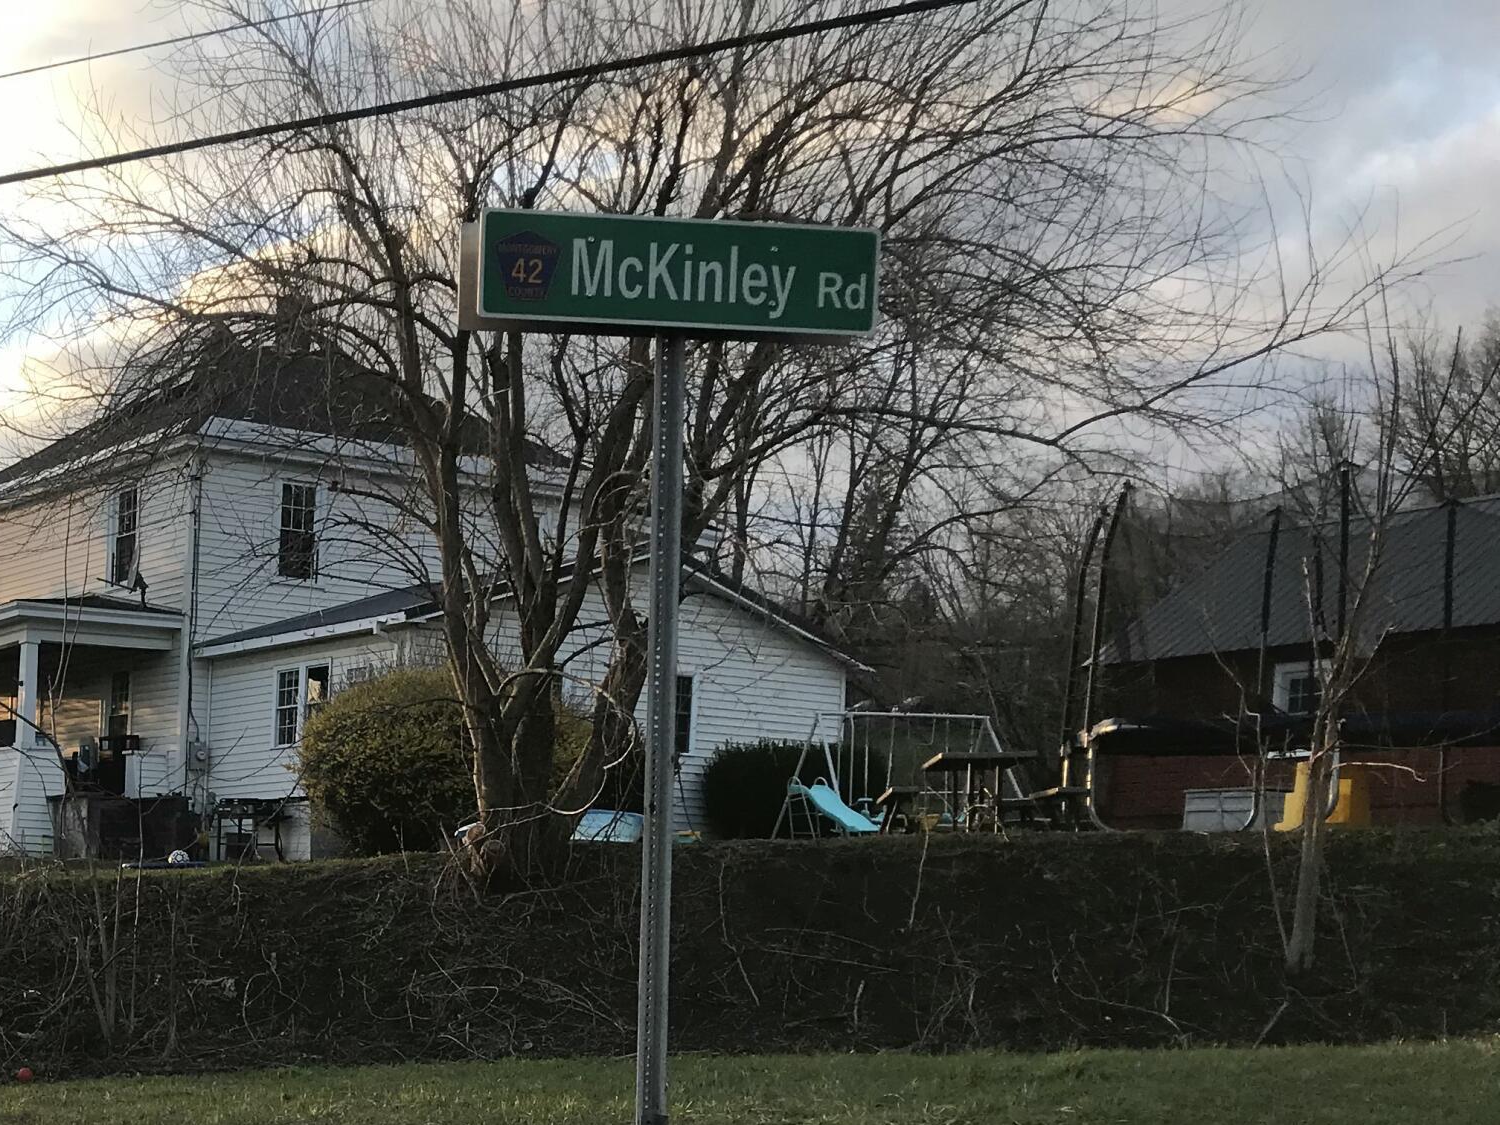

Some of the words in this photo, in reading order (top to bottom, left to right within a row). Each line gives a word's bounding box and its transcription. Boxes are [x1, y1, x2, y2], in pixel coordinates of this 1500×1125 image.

[512, 258, 542, 283] 42
[571, 237, 796, 319] McKinley
[817, 272, 867, 310] Rd
